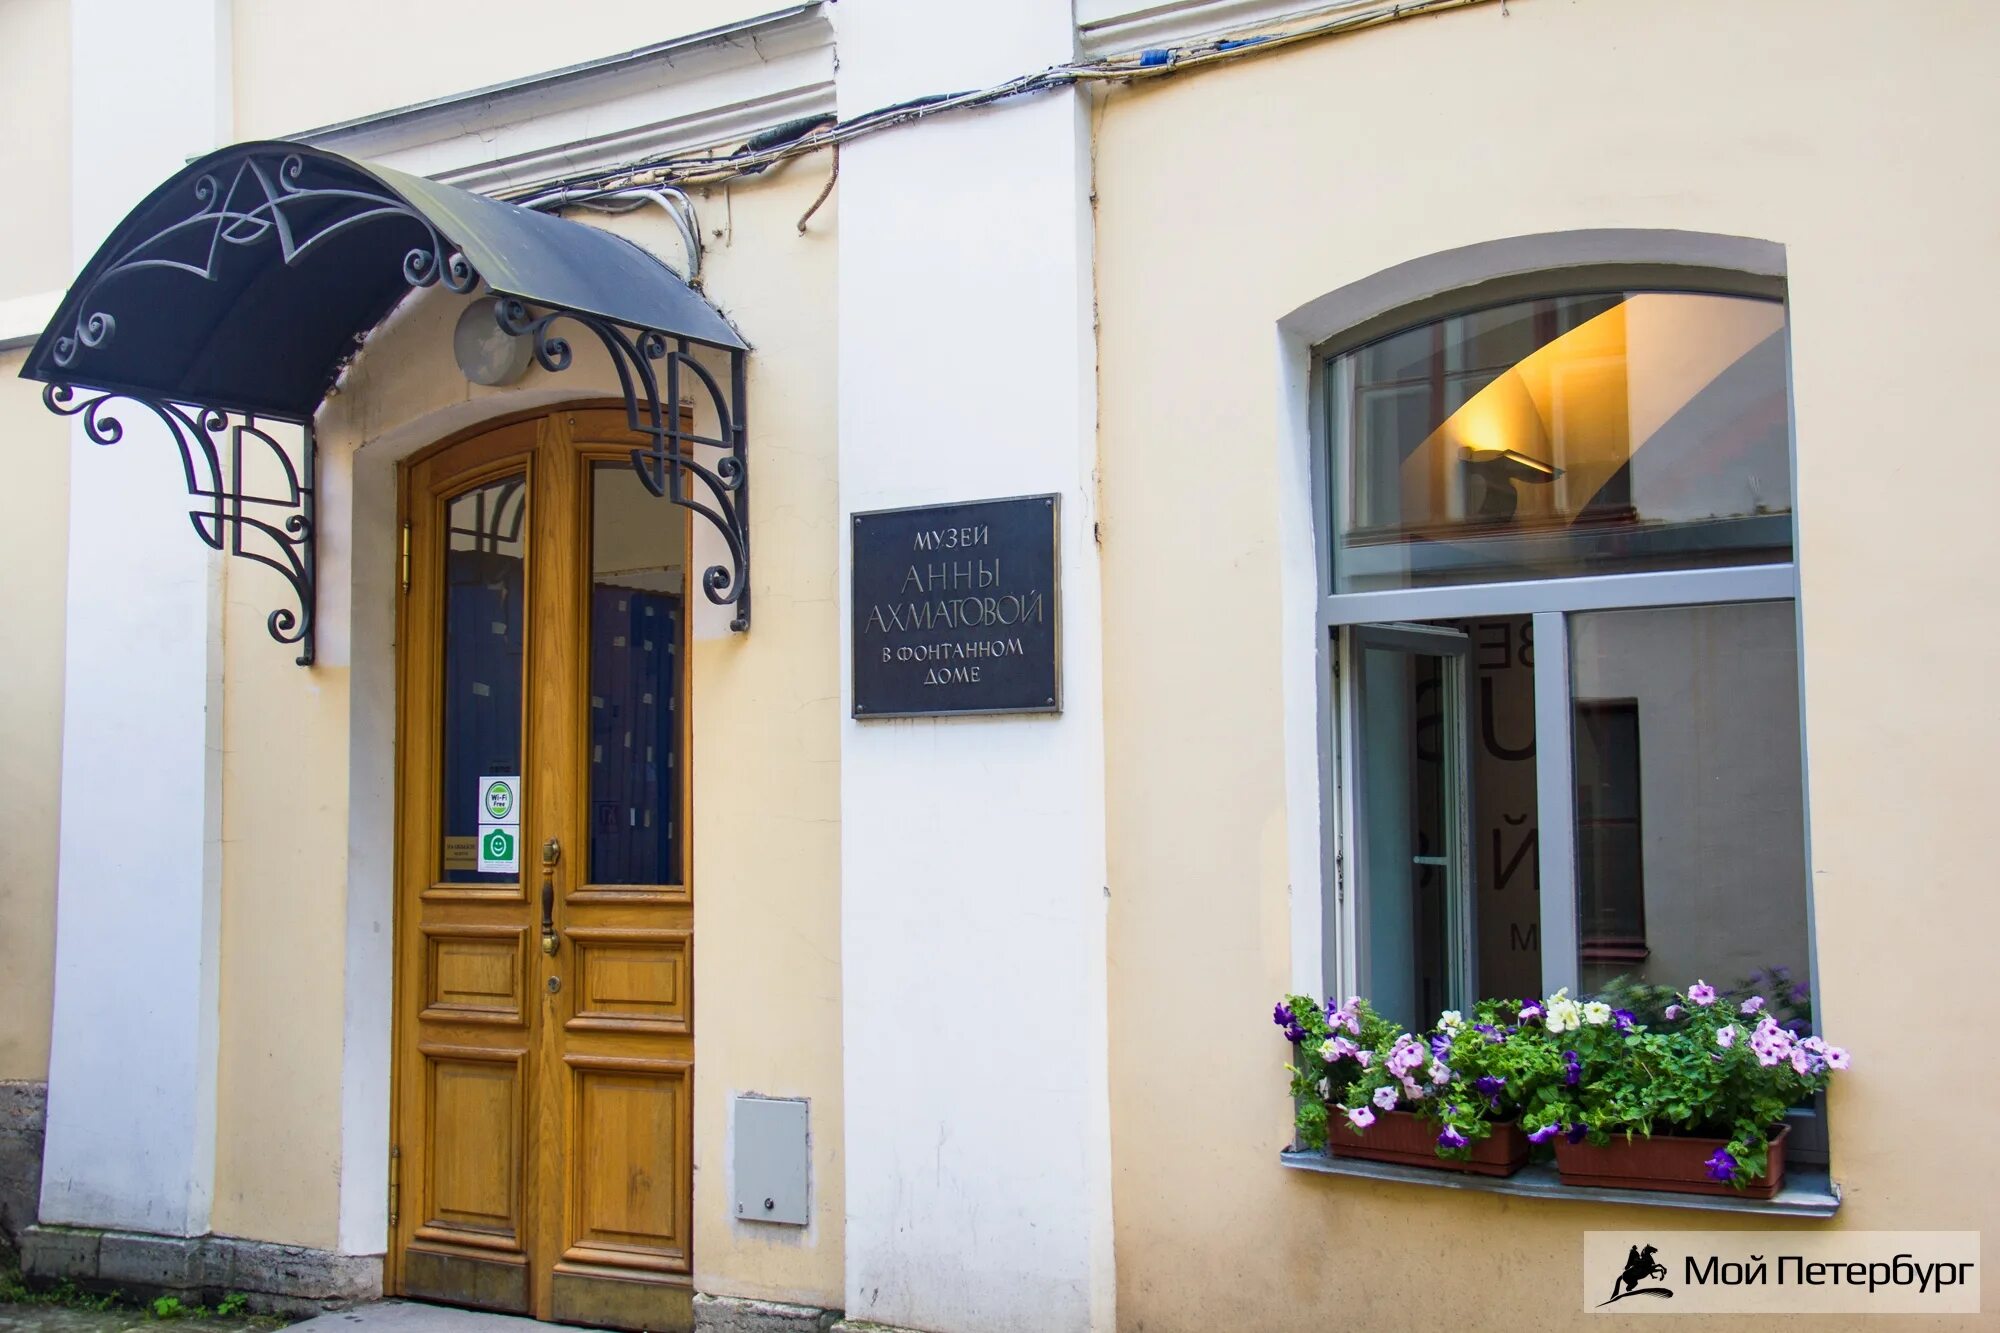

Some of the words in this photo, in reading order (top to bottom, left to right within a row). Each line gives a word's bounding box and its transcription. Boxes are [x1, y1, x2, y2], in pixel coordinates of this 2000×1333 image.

[913, 524, 989, 551] МУЗЕЙ
[901, 558, 1000, 594] АННЫ
[865, 589, 1043, 634] АХМАТОВОЙ
[882, 647, 892, 663] В
[896, 637, 1024, 662] ФОНТАННОМ
[923, 666, 981, 685] ДОМЕ
